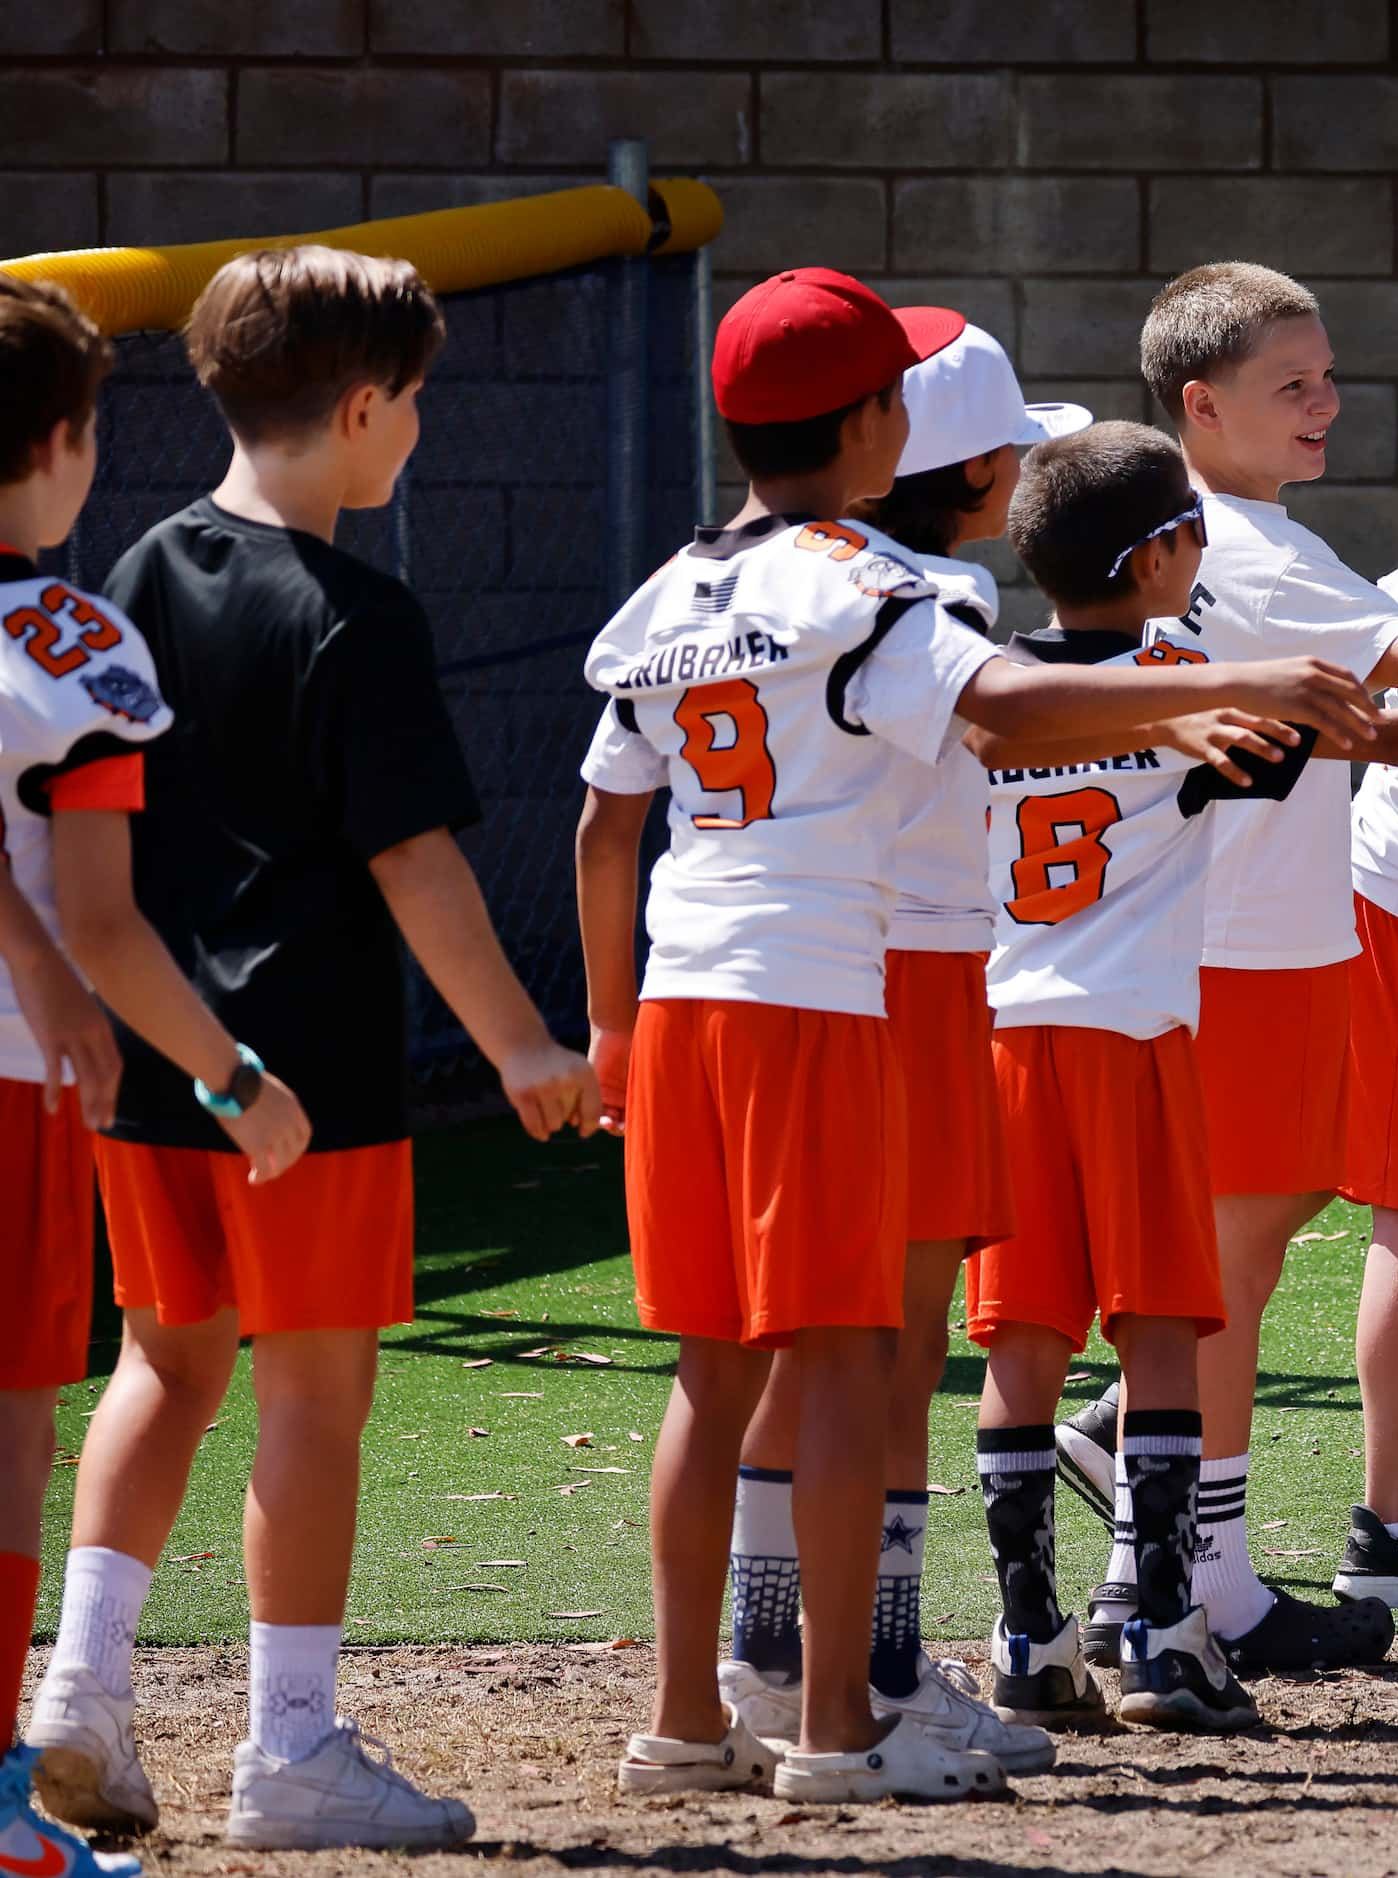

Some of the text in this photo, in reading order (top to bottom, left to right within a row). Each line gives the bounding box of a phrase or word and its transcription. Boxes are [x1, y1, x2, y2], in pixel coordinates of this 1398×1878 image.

[794, 520, 869, 562] 9
[3, 584, 122, 679] 23
[673, 678, 776, 830] 9
[1003, 787, 1123, 926] 8
